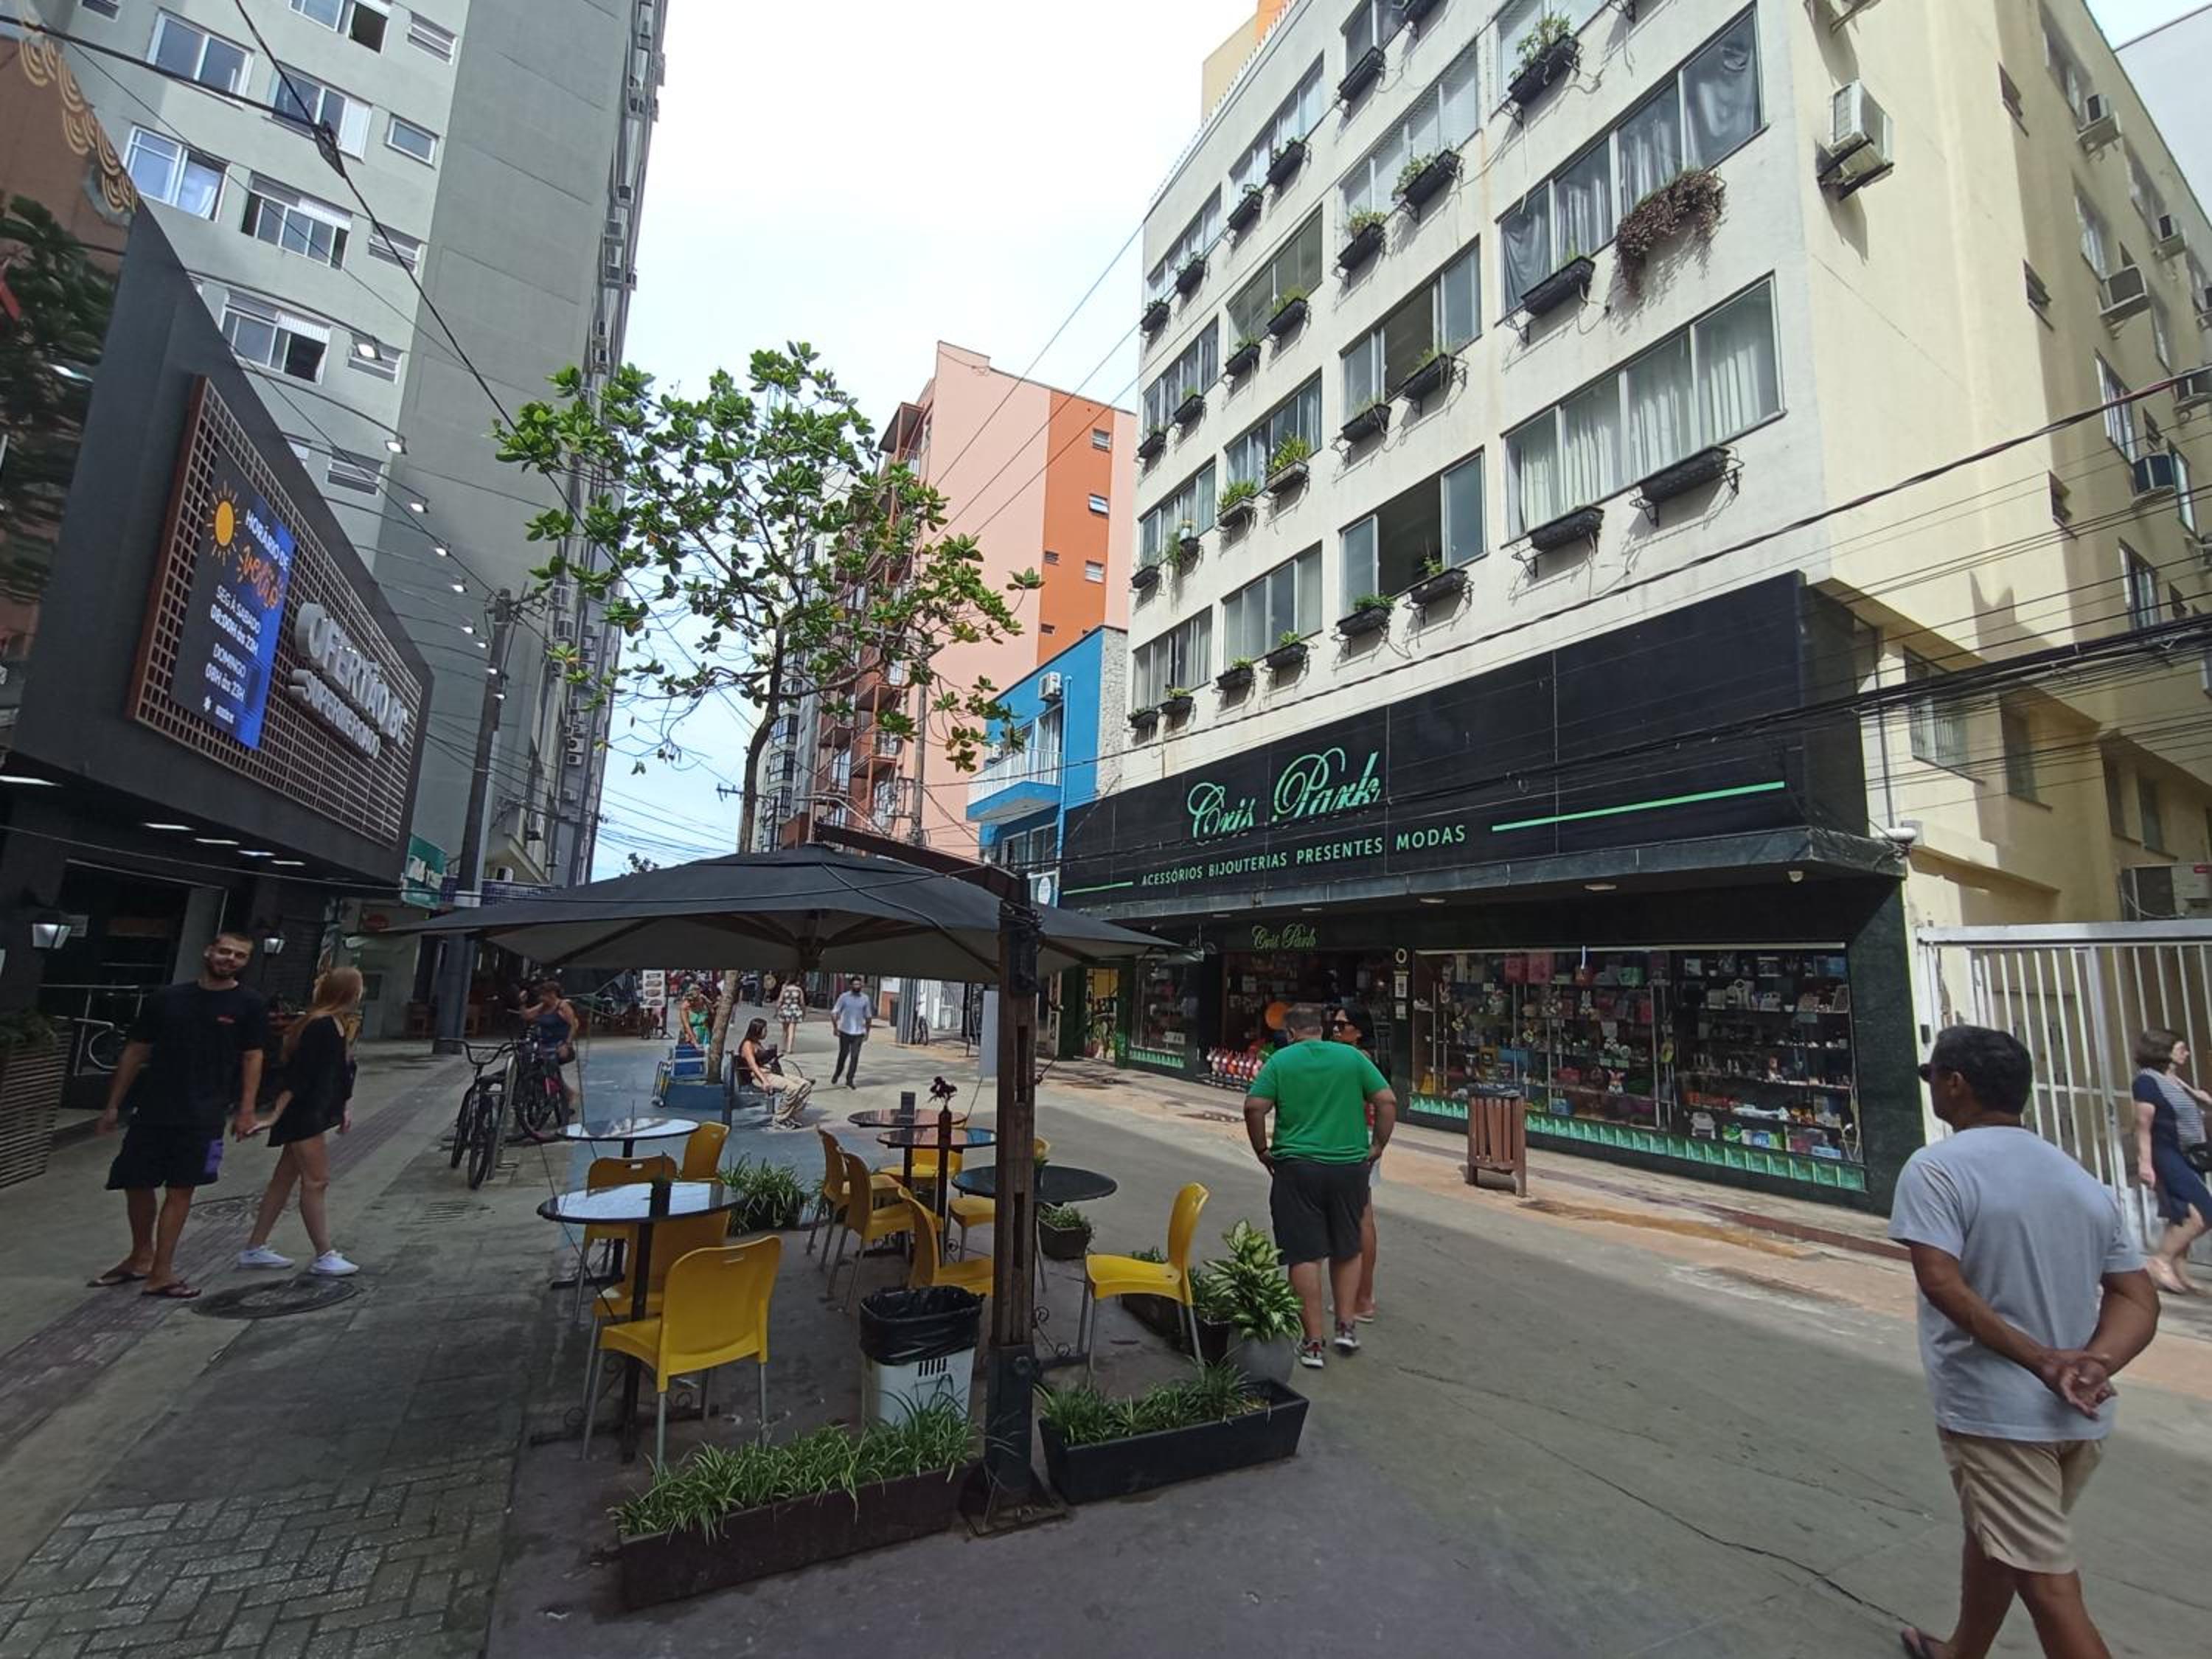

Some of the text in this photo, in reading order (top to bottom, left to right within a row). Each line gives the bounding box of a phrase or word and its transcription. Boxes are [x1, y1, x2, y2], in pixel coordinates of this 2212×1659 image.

[246, 509, 290, 571] HORÁRIO DE
[216, 584, 232, 608] SEG
[213, 642, 246, 678] DOMINGO
[1270, 747, 1381, 826] Park
[1141, 824, 1467, 886] ACESSÓRIOS BIJOUTERIAS PRESENTES MODAS
